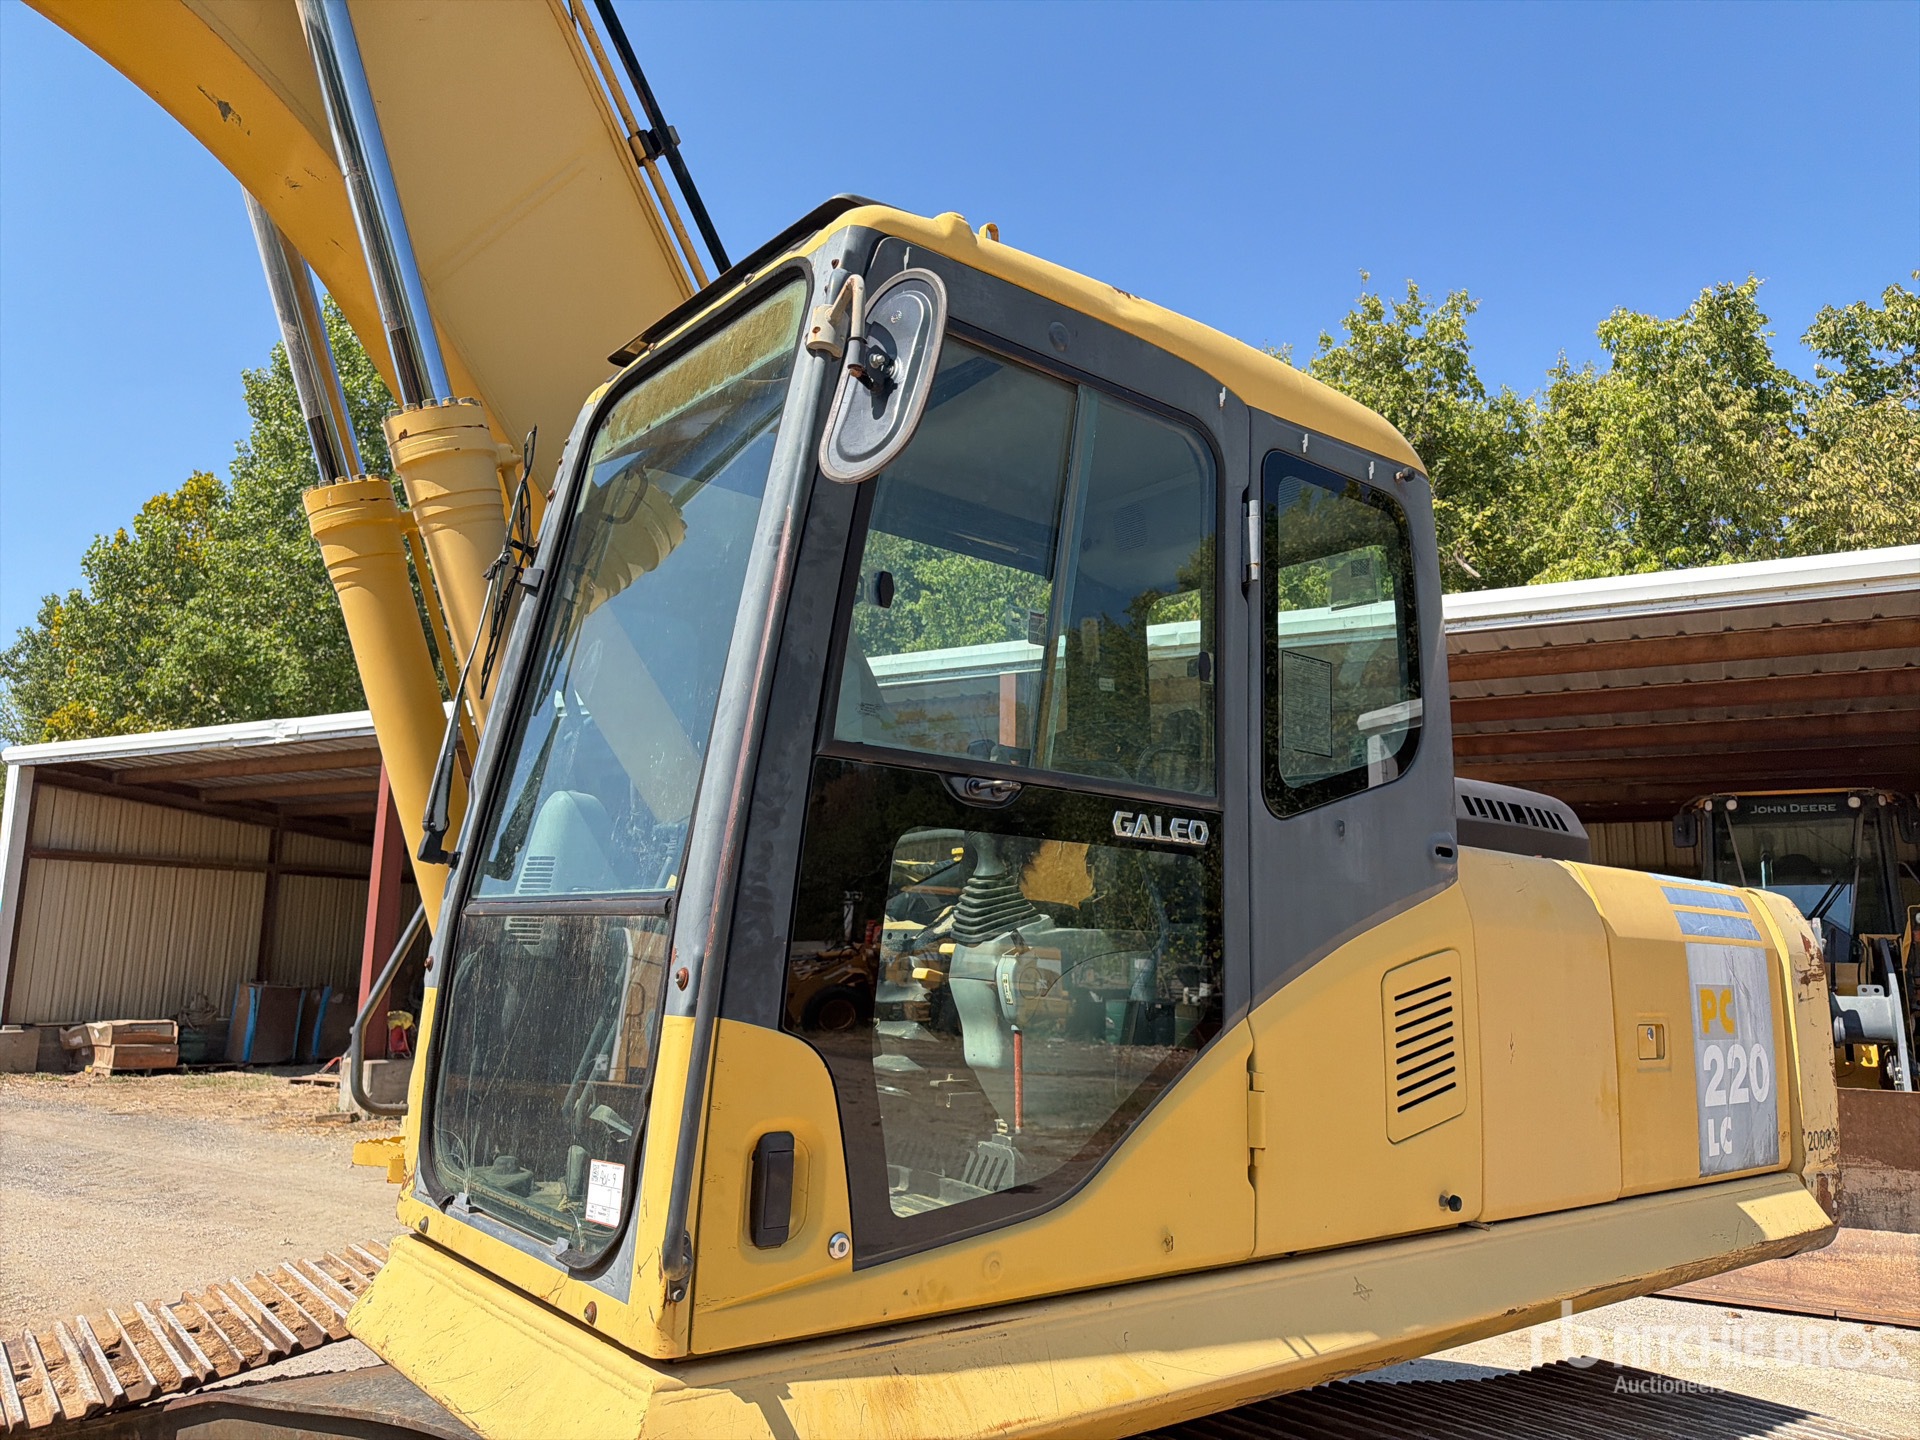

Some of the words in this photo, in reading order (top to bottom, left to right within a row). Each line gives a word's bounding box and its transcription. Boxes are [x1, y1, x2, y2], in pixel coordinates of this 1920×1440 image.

[1112, 810, 1210, 846] GALEO
[1750, 804, 1787, 814] JOHN
[1789, 803, 1837, 813] DEERE
[1699, 988, 1735, 1035] PC
[1703, 1043, 1770, 1107] 220
[1707, 1116, 1733, 1157] LC
